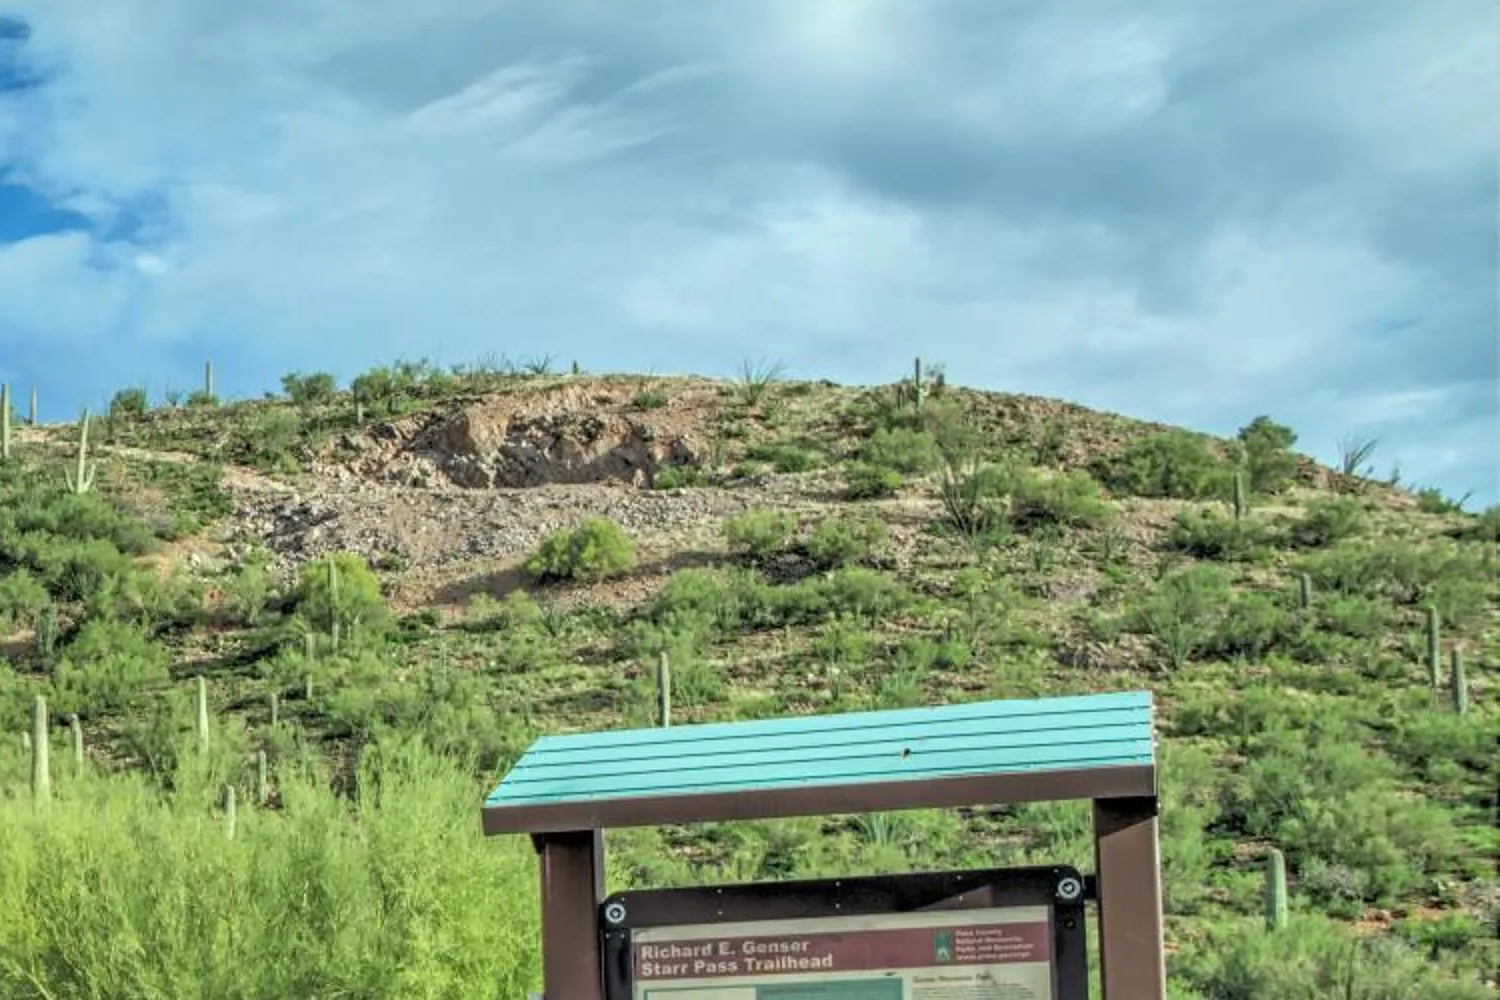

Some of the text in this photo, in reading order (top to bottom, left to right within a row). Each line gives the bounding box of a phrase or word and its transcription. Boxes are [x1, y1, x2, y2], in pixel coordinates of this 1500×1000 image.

[641, 940, 811, 960] Richard E. Genser
[641, 953, 833, 977] Starr Pass Trailhead
